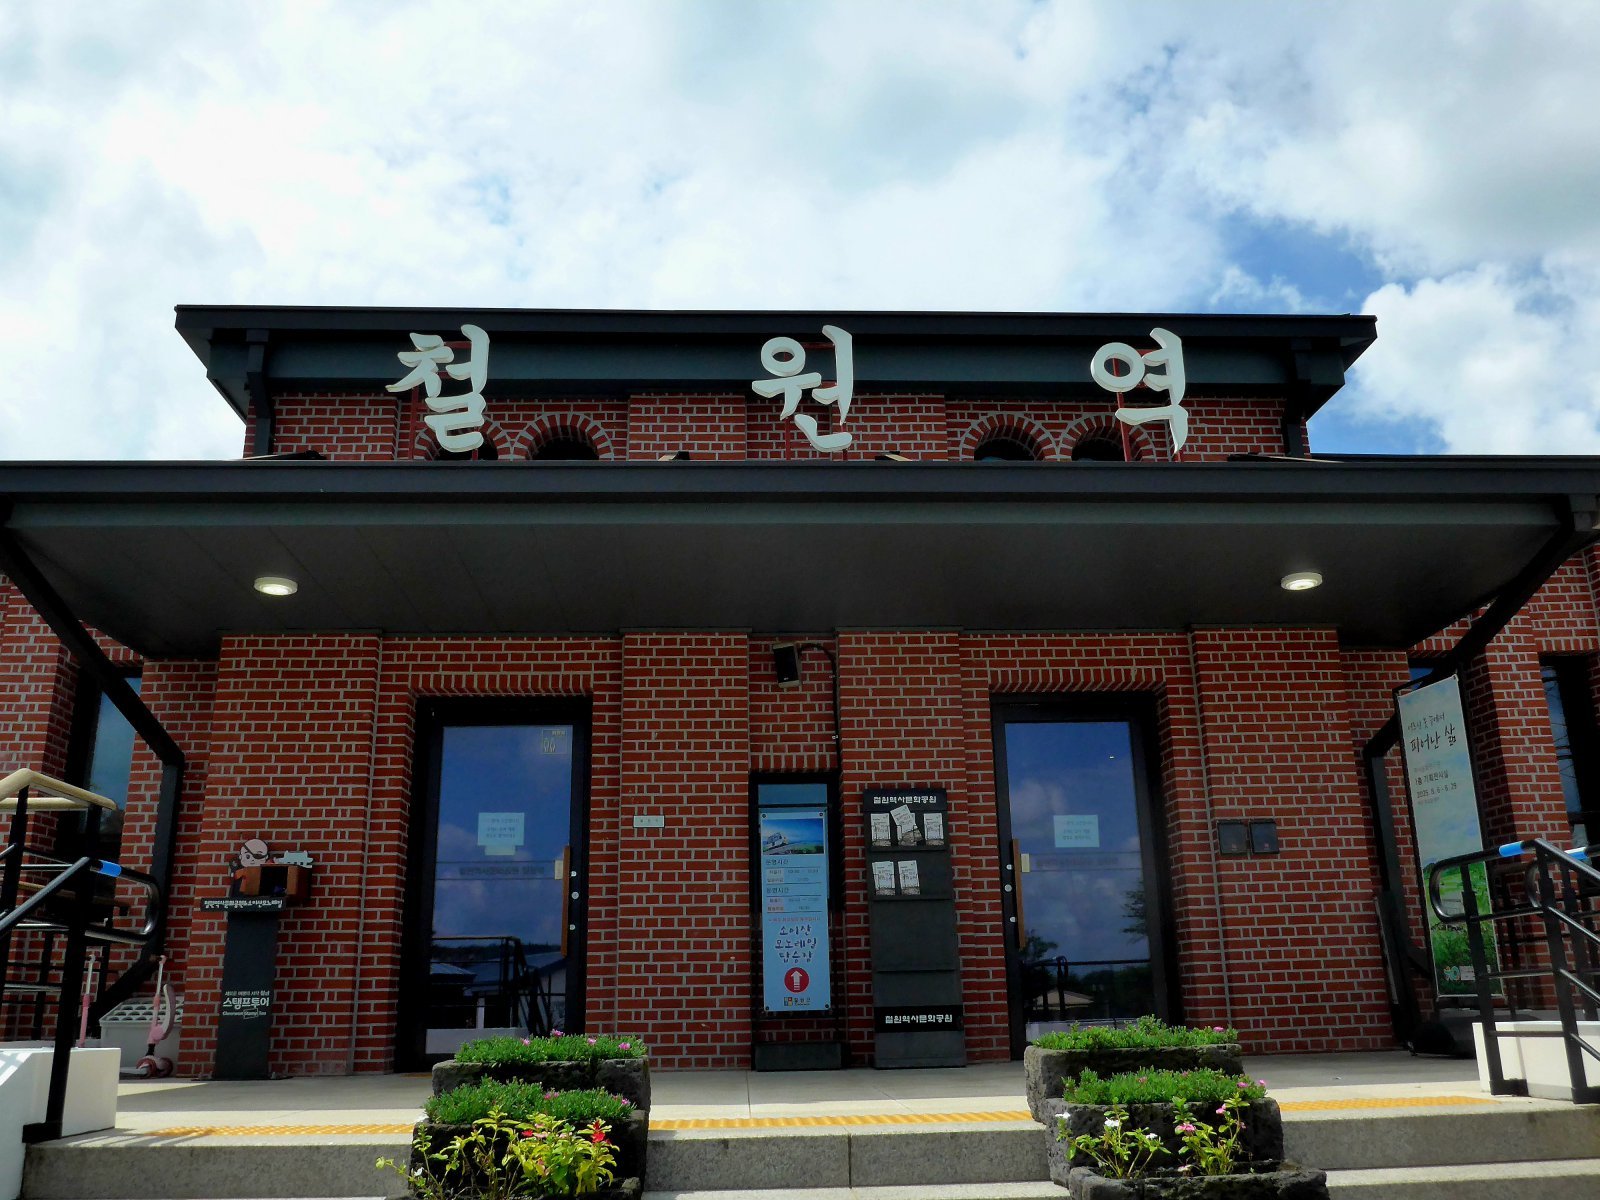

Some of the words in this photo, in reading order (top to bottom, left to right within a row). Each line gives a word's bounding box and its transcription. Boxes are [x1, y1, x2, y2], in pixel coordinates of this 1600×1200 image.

[1410, 731, 1441, 753] 피어난
[1444, 723, 1457, 747] 삶
[1424, 770, 1449, 784] 기획전시실
[873, 795, 937, 805] 철원역사문화공원
[779, 924, 812, 936] 소이산
[775, 937, 817, 949] 모노레일
[779, 951, 813, 964] 탑승장
[222, 997, 270, 1010] 스탬프투어
[885, 1014, 953, 1024] 철원역사문화공원
